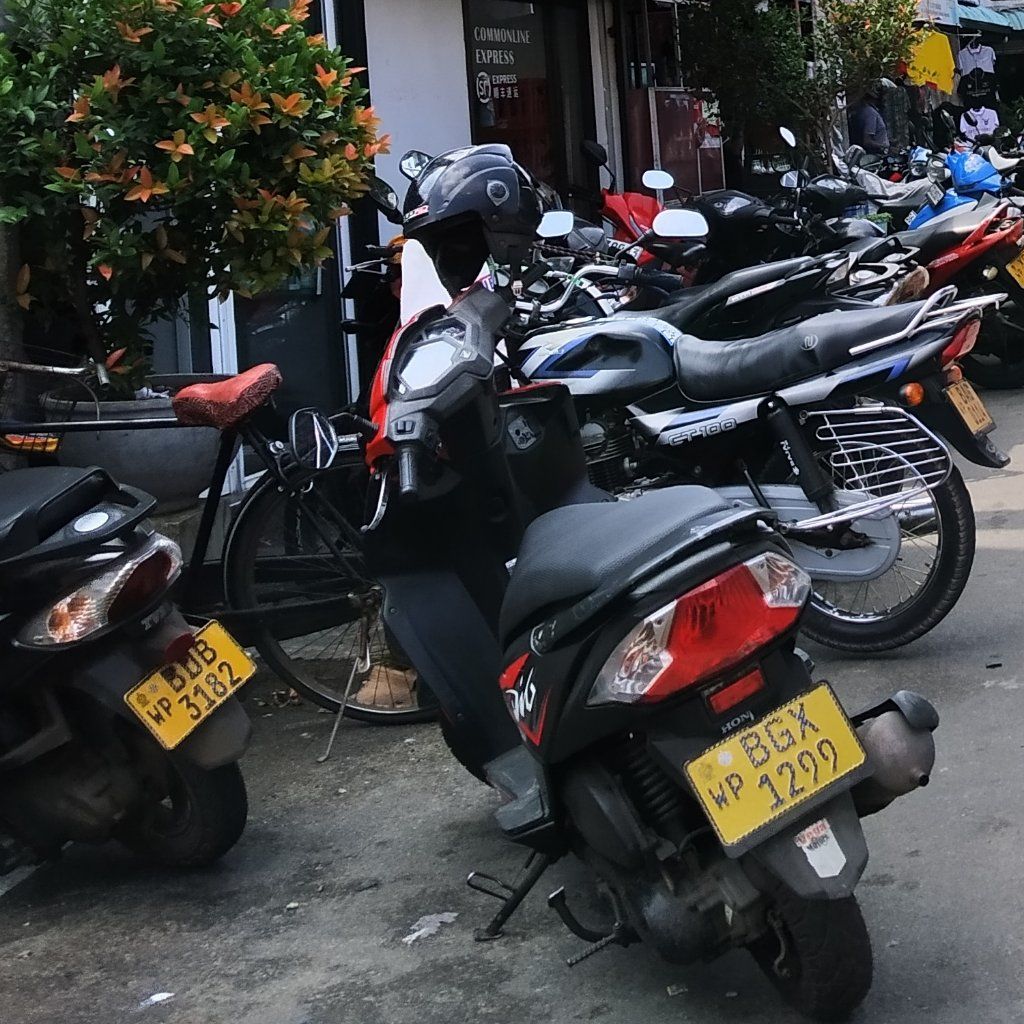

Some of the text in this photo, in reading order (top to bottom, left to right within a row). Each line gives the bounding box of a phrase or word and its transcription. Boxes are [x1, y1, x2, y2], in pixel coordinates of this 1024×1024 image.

[474, 26, 532, 44] COMMONLINE
[475, 48, 515, 65] EXPRESS
[492, 74, 518, 85] EXPRESS
[178, 661, 243, 721] 3182
[146, 696, 172, 727] WP
[721, 711, 755, 734] HON
[739, 702, 820, 769] BGX
[708, 772, 744, 810] WP
